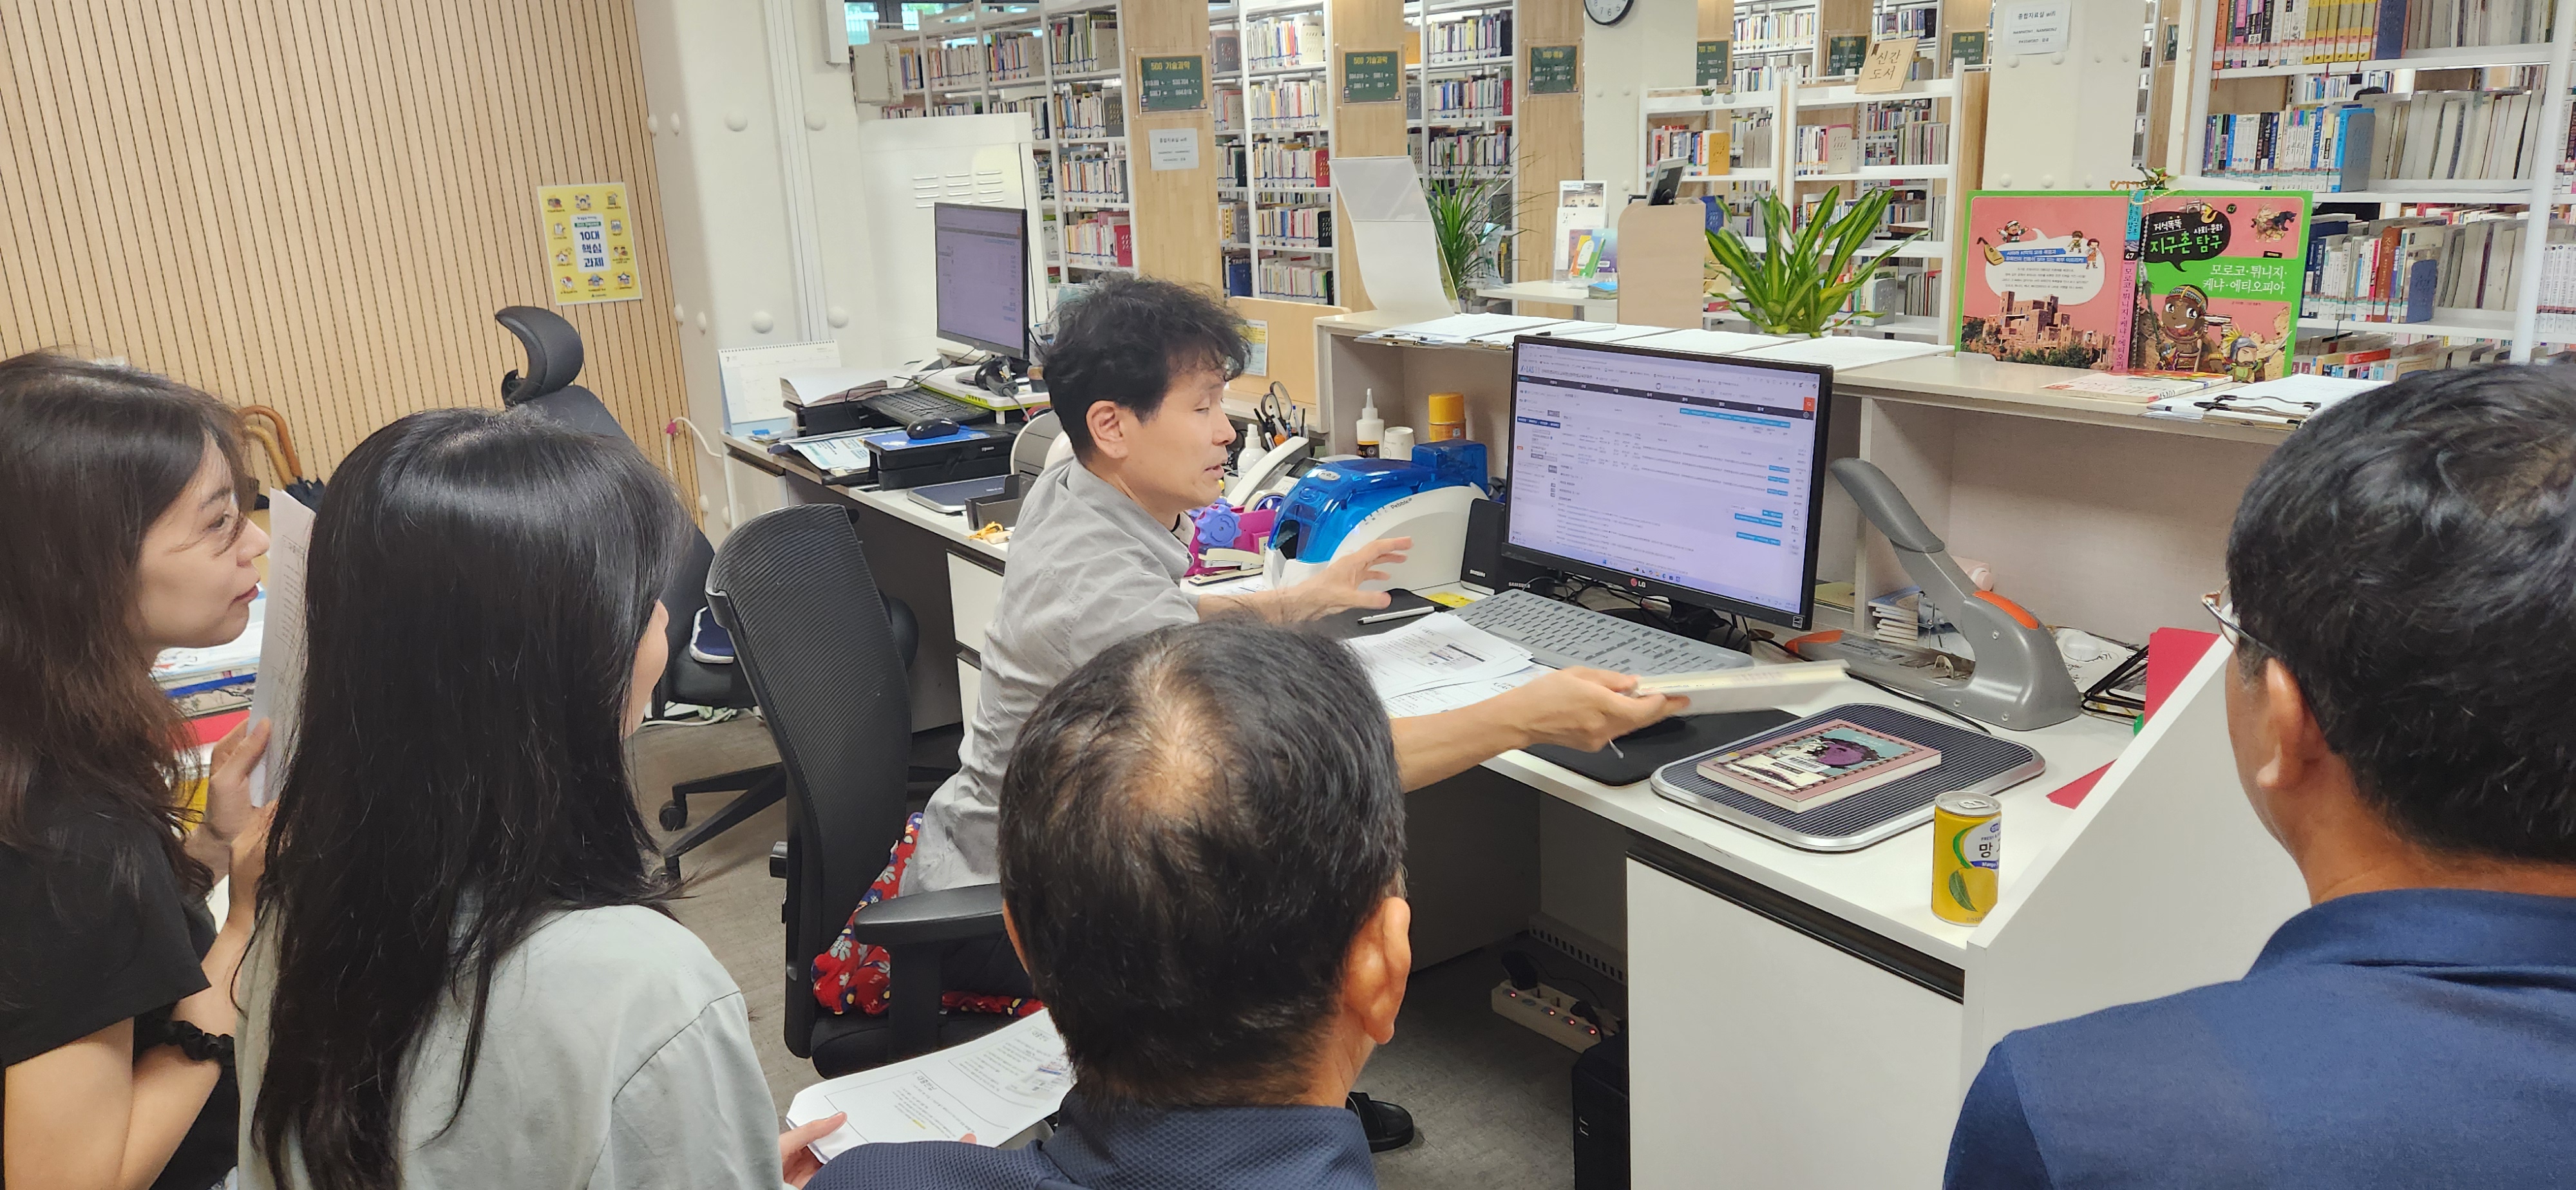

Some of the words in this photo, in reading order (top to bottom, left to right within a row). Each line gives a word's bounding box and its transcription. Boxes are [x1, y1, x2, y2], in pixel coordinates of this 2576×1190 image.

[1876, 50, 1902, 65] 신간
[1151, 62, 1162, 71] 500
[1165, 61, 1191, 70] 기술과학
[1869, 66, 1895, 80] 도서
[2153, 218, 2183, 232] 지식똑똑
[580, 230, 600, 240] 10대
[582, 243, 602, 254] 핵심
[2150, 231, 2193, 254] 지구촌
[2196, 234, 2222, 253] 탐구
[583, 257, 604, 267] 과제
[2202, 278, 2286, 295] 케냐·에티오피아
[1469, 569, 1486, 578] SAMSUNG
